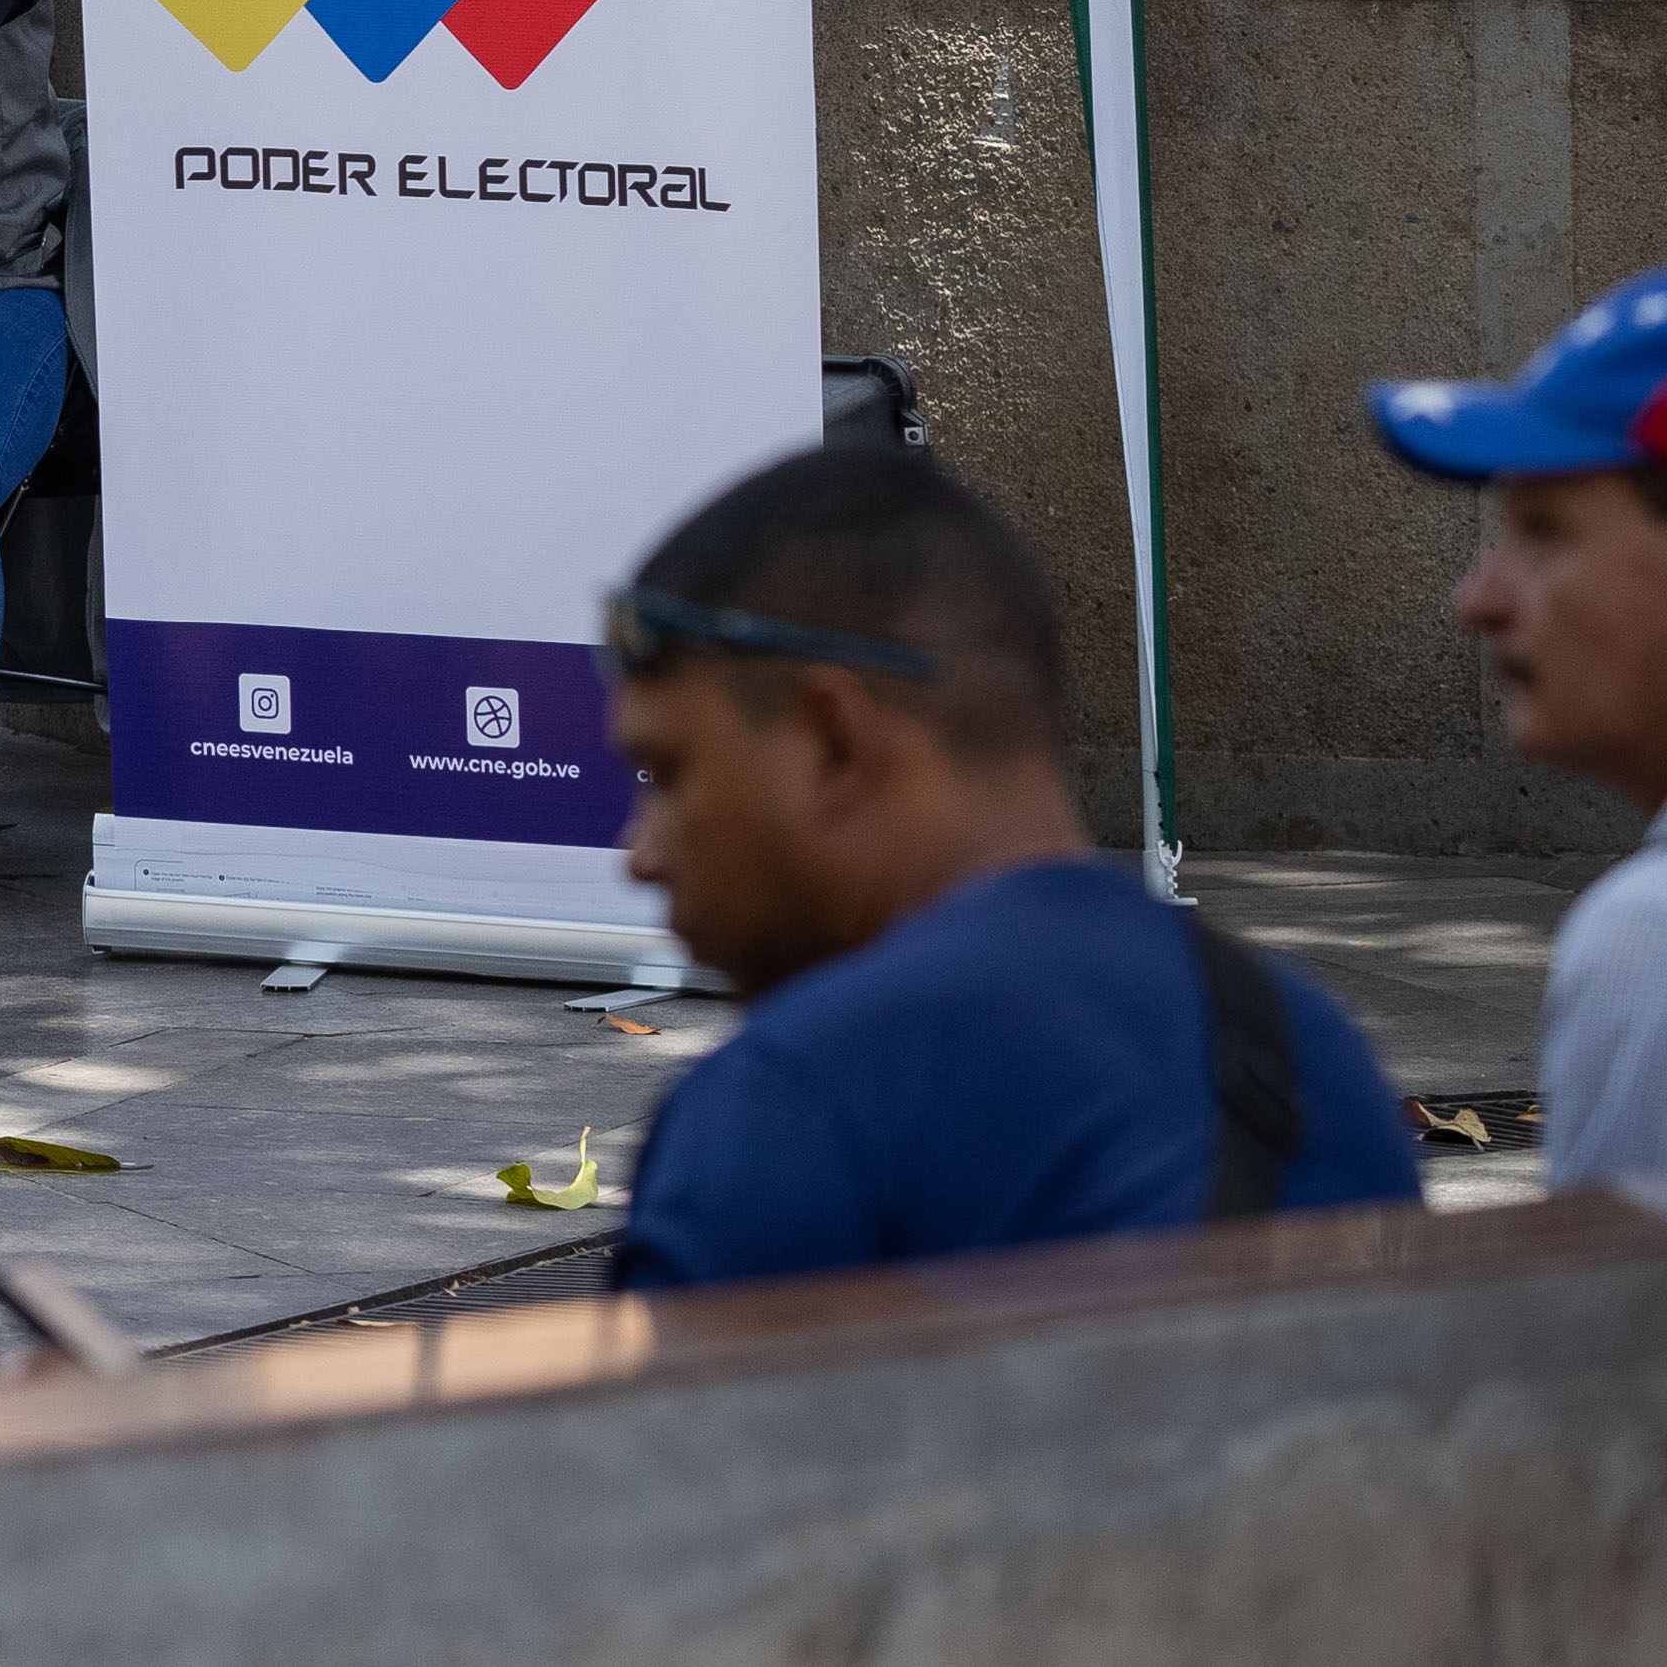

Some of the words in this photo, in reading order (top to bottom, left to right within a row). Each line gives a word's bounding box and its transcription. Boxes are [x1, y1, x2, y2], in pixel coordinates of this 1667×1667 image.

[174, 146, 378, 198] PODER
[398, 154, 732, 212] ELECTORAL
[189, 739, 354, 765] cneesvenezuela
[409, 753, 581, 780] www.cne.gob.ve
